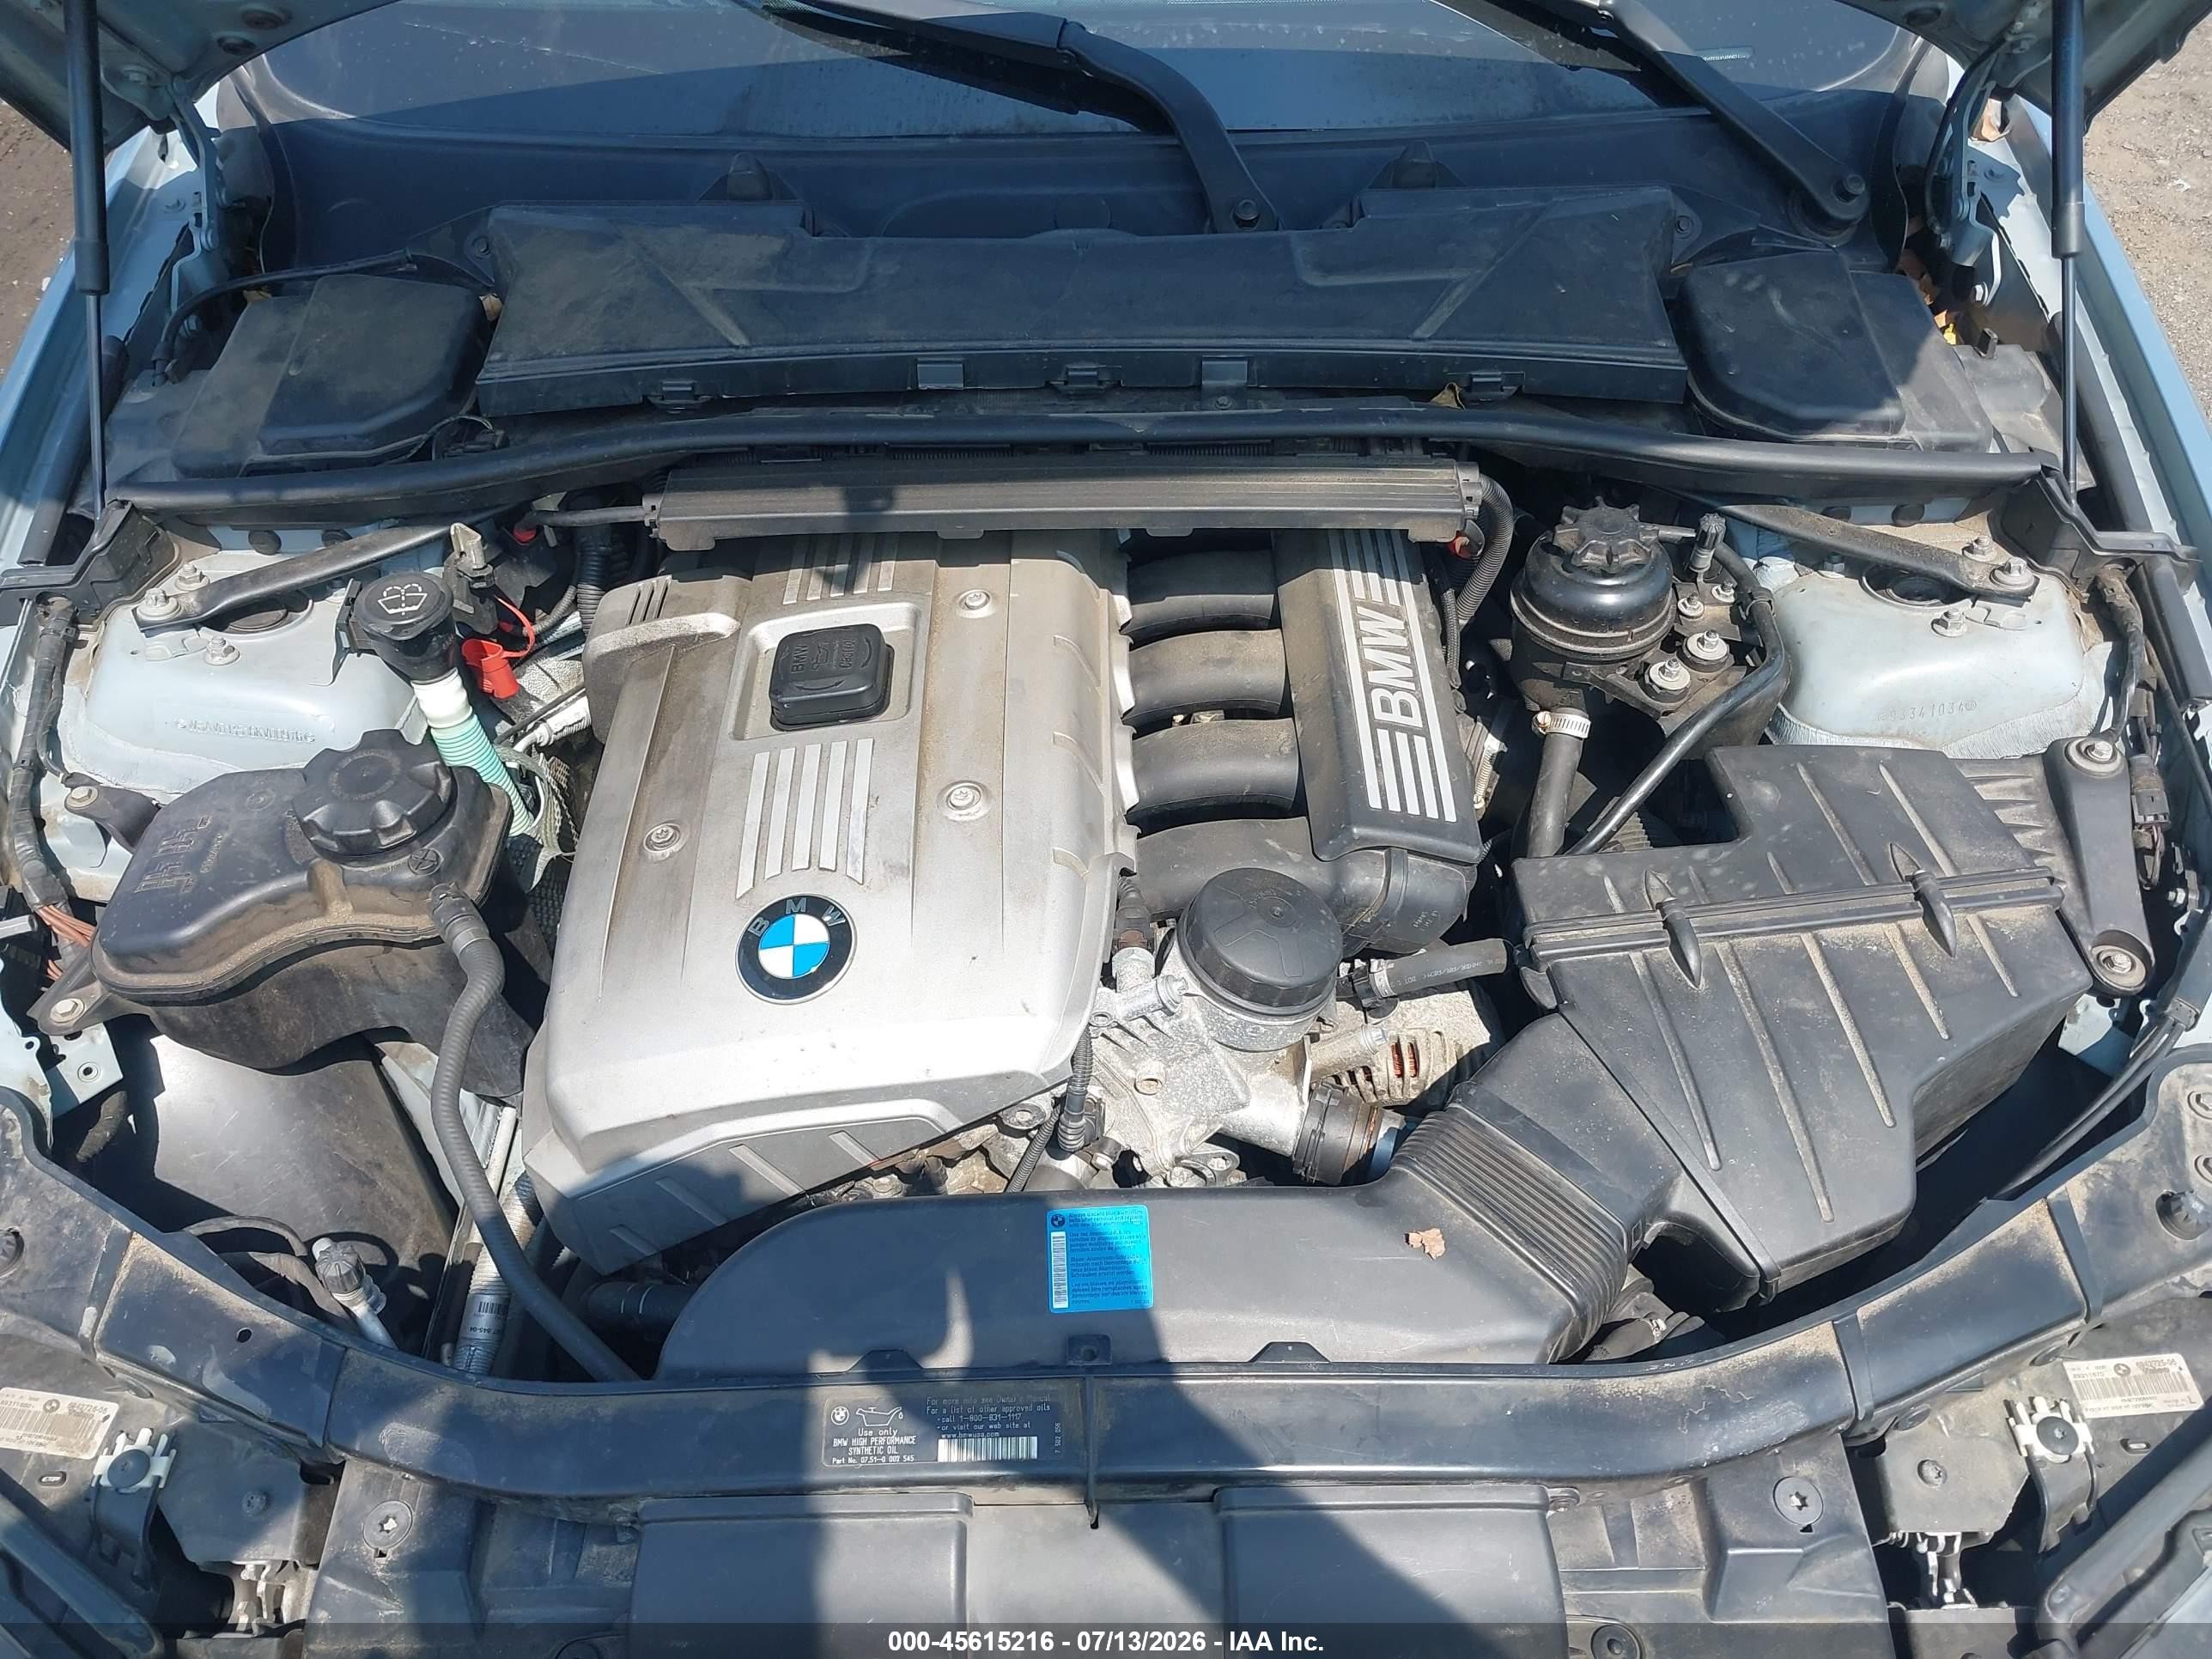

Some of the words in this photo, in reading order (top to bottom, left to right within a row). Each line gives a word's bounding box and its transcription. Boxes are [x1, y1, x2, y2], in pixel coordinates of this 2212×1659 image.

[791, 645, 809, 674] BMW
[1357, 605, 1423, 728] BMW
[748, 897, 846, 938] BMW
[927, 1396, 938, 1405] For
[927, 1406, 938, 1415] For
[1002, 1404, 1032, 1413] approved
[1036, 1403, 1050, 1412] oils
[858, 1427, 873, 1437] Use
[878, 1426, 898, 1437] only
[833, 1437, 848, 1447] BMW
[852, 1437, 867, 1446] HIGH
[871, 1435, 917, 1446] PERFORMANCE
[848, 1446, 884, 1455] SYNTHETIC
[887, 1445, 899, 1455] OIL
